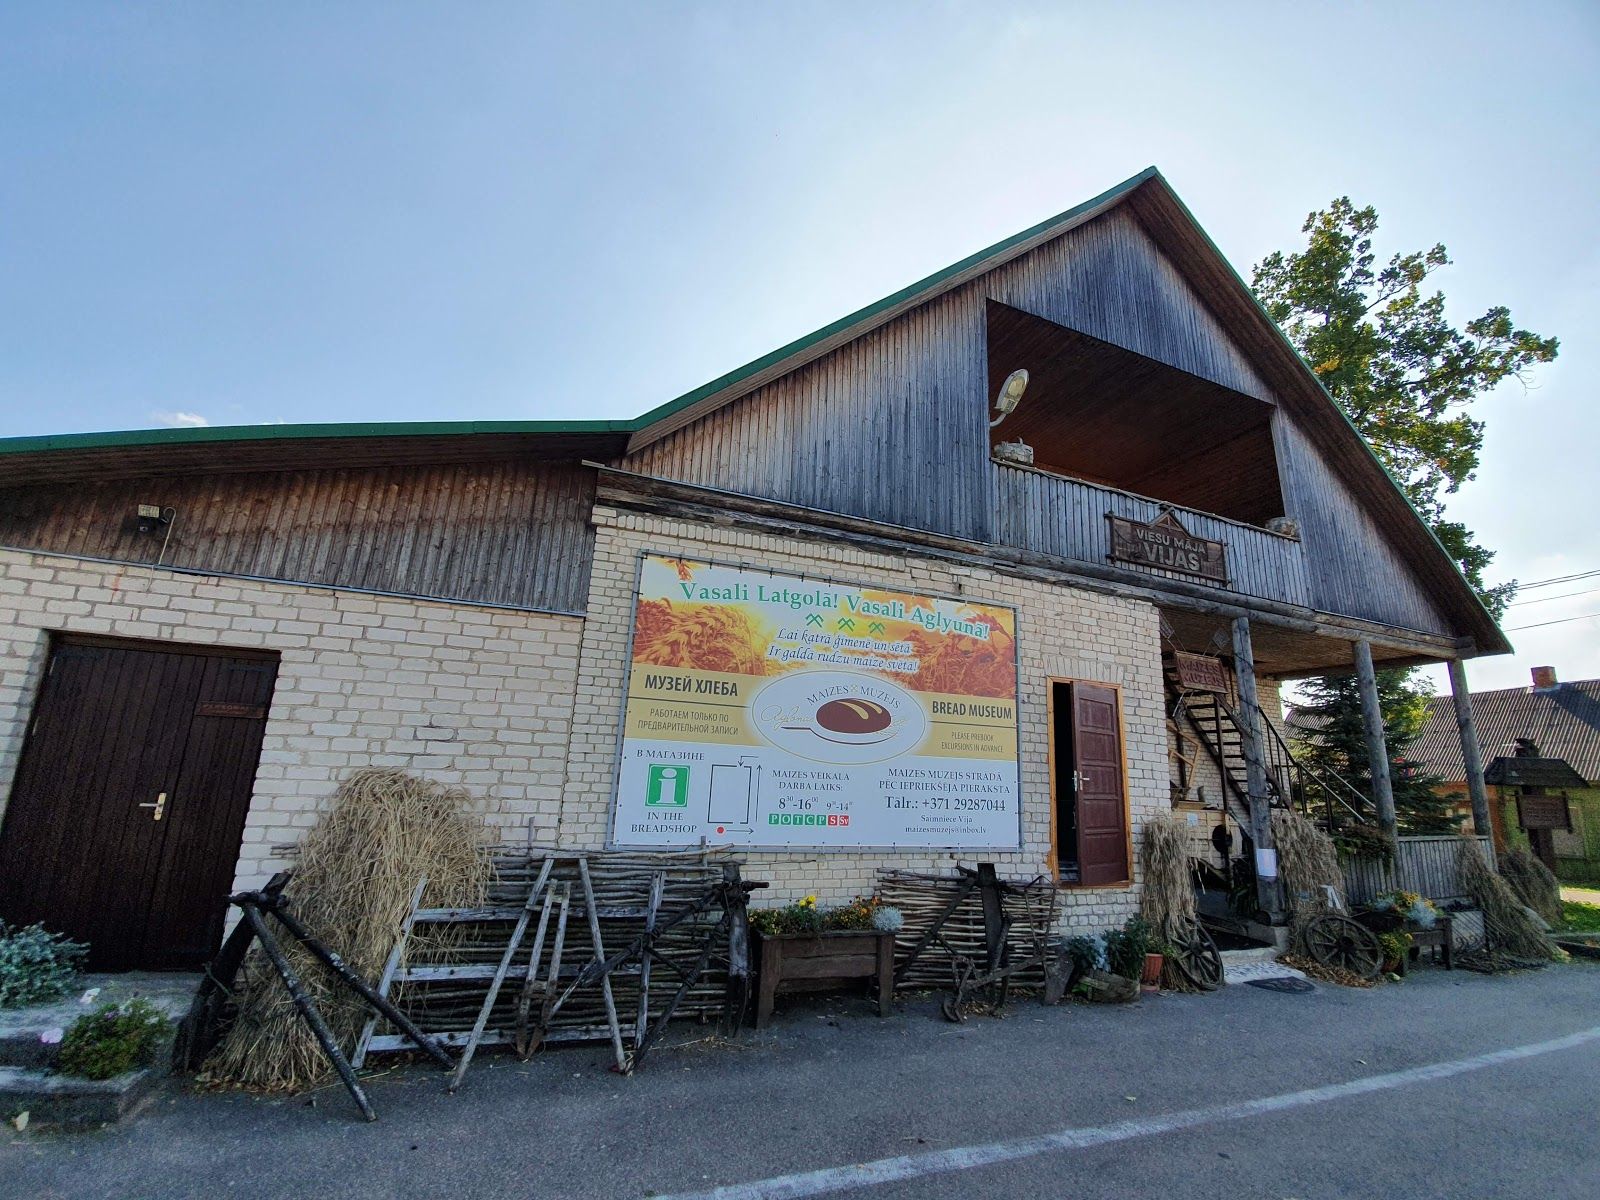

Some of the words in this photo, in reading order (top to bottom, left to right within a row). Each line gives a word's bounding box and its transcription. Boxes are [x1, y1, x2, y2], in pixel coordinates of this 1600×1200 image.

[1136, 528, 1171, 546] VIESU
[1143, 541, 1200, 571] VIJAS
[679, 582, 749, 600] Vasali
[757, 585, 838, 610] Latgolā!
[846, 594, 904, 619] Vasali
[911, 607, 990, 640] Aglyunā!
[776, 628, 799, 640] Lai
[874, 642, 887, 651] un
[768, 645, 781, 657] Ir
[817, 650, 850, 665] rudzu
[853, 656, 884, 668] maize
[645, 674, 692, 693] МУЗЕЙ
[695, 678, 738, 697] ХЛЕБА
[806, 685, 849, 706] MAIZES
[860, 686, 901, 709] MUZEJS
[649, 708, 689, 720] РАБОТАЕМ
[691, 711, 718, 722] ТОЛЬКО
[719, 713, 729, 723] ПО
[932, 700, 966, 716] BREAD
[968, 704, 1012, 720] MUSEUM
[637, 719, 709, 734] ПРЕДВАРИТЕЛЬНОЙ
[711, 725, 739, 736] ЗАПИСИ
[951, 731, 970, 741] PLEASE
[636, 749, 643, 758] В
[646, 749, 705, 761] МАГАЗИНЕ
[973, 744, 980, 752] IN
[772, 769, 808, 779] MAIZES
[810, 771, 850, 781] VEIKALA
[888, 768, 926, 777] MAIZES
[928, 770, 964, 780] MUZEJS
[778, 781, 812, 790] DARBA
[814, 782, 843, 791] LAIKS:
[960, 783, 1010, 794] PIERAKSTA
[885, 796, 918, 809] Tālr.:
[922, 797, 950, 810] +371
[953, 798, 1006, 811] 29287044
[647, 811, 658, 820] IN
[663, 812, 684, 821] THE
[920, 814, 957, 823] Saimniece
[958, 815, 973, 825] Vija
[631, 823, 697, 833] BREADSHOP
